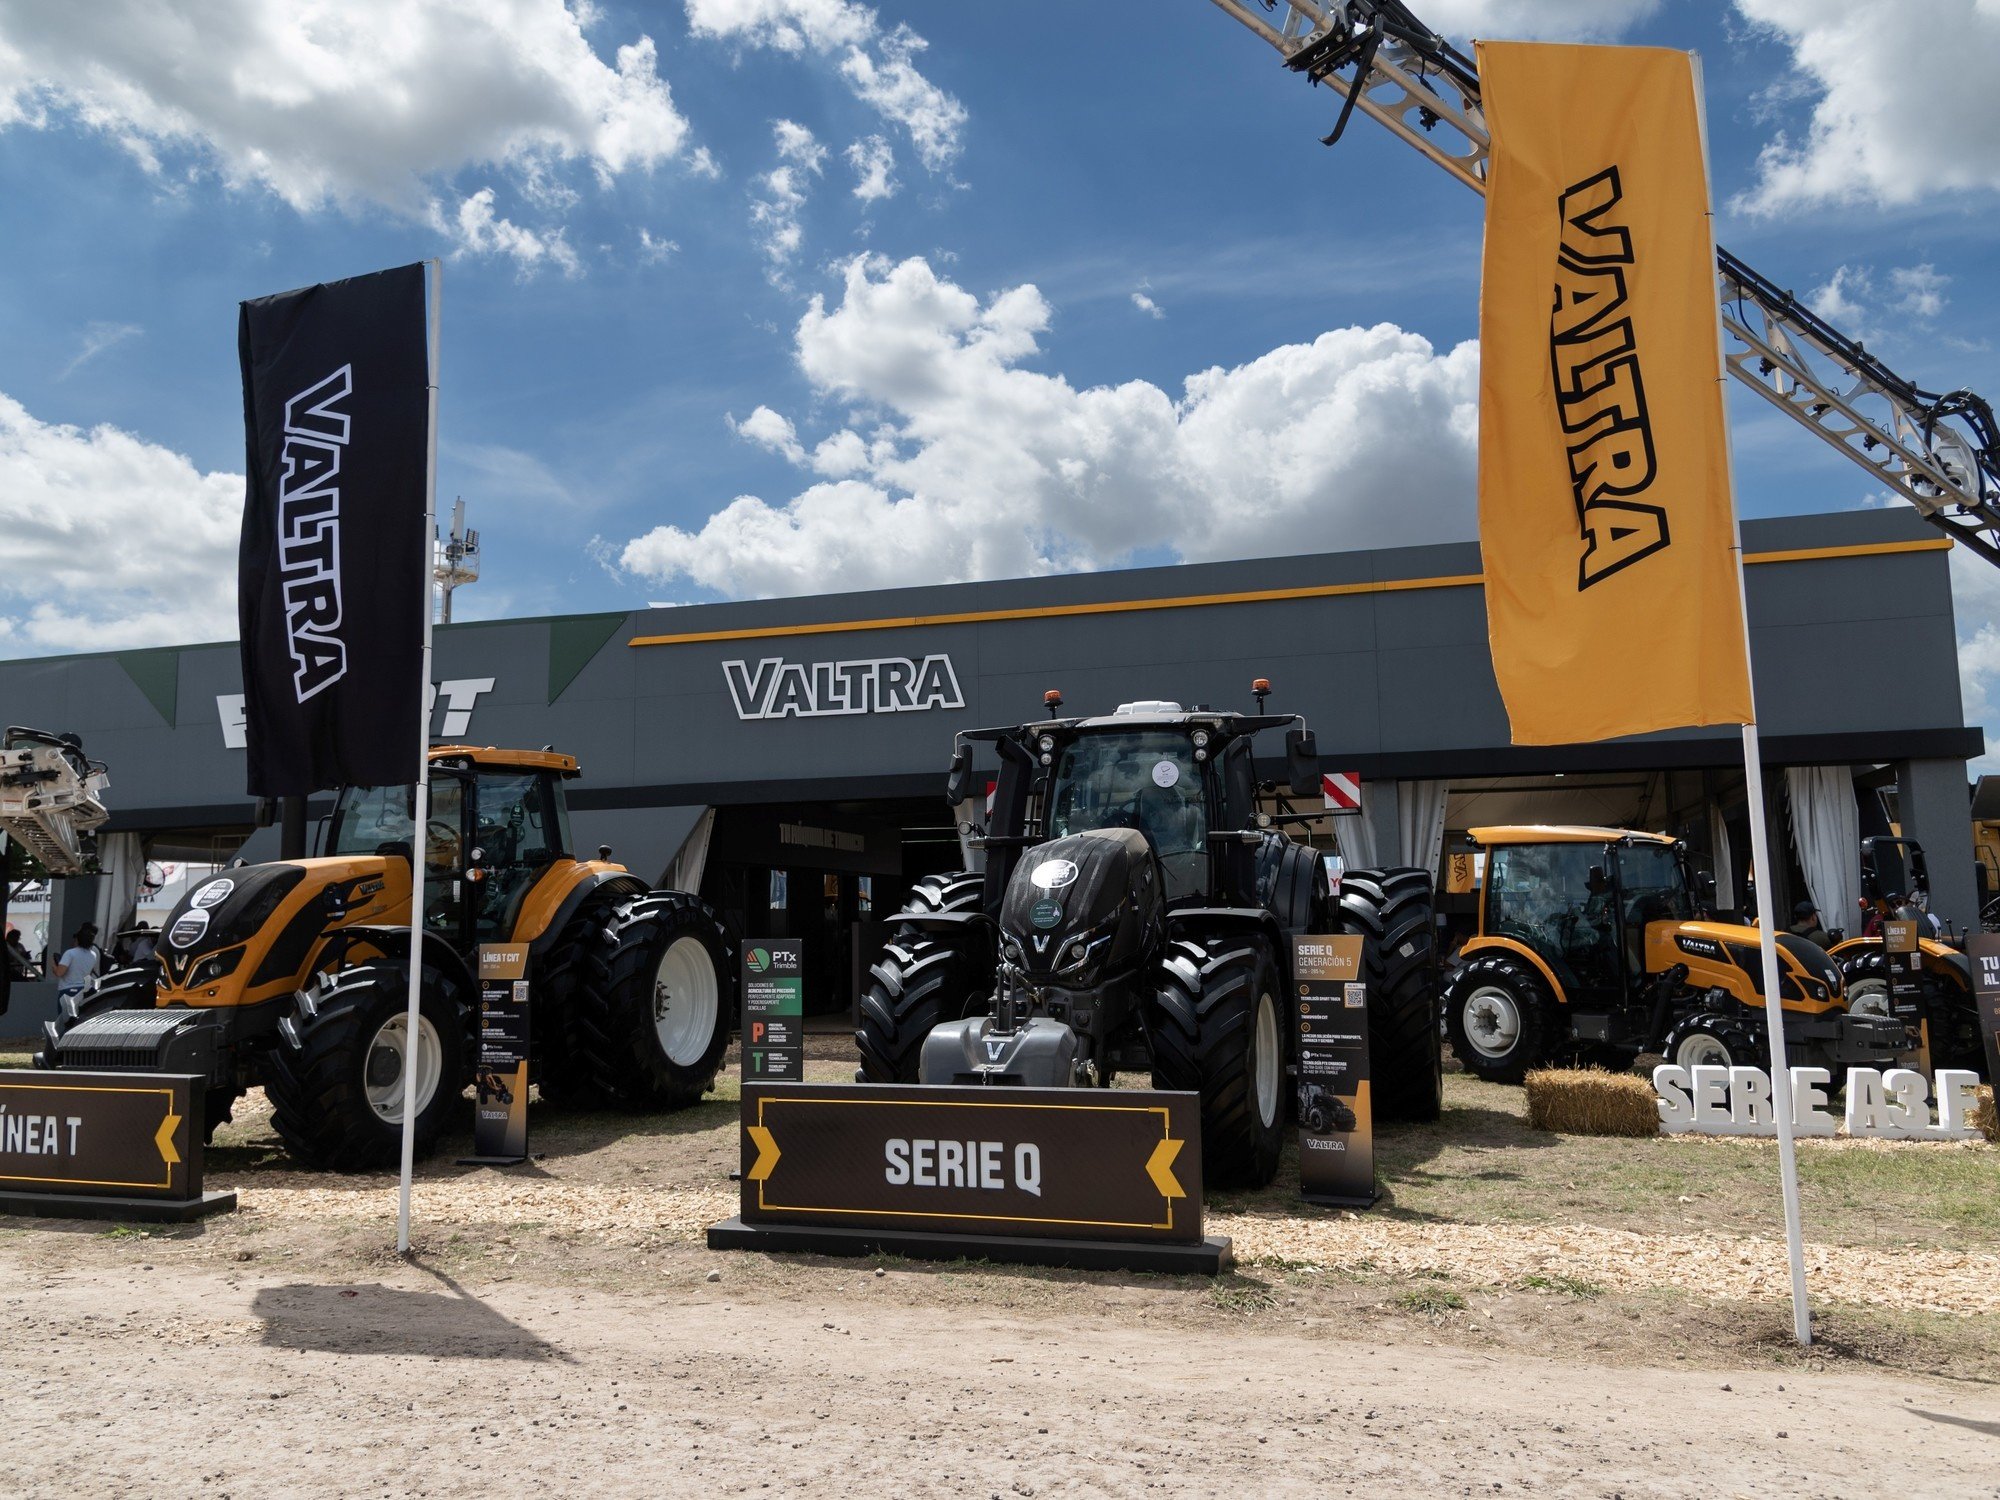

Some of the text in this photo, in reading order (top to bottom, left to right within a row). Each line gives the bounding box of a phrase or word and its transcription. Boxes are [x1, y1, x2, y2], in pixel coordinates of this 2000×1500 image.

[1551, 165, 1671, 592] VALTRA
[278, 363, 352, 704] VALTRA
[722, 654, 966, 720] VALTRA
[483, 952, 520, 962] LÍNEA T CVT
[772, 952, 796, 961] PTx
[1298, 945, 1333, 956] SERIE Q
[1299, 955, 1352, 966] GENERACIÓN 5
[753, 1022, 764, 1042] P
[753, 1052, 763, 1072] T
[1653, 1065, 1831, 1126] SERE
[66, 1116, 82, 1156] T
[1306, 1139, 1345, 1150] VALTRA
[885, 1138, 1042, 1198] SERIE Q
